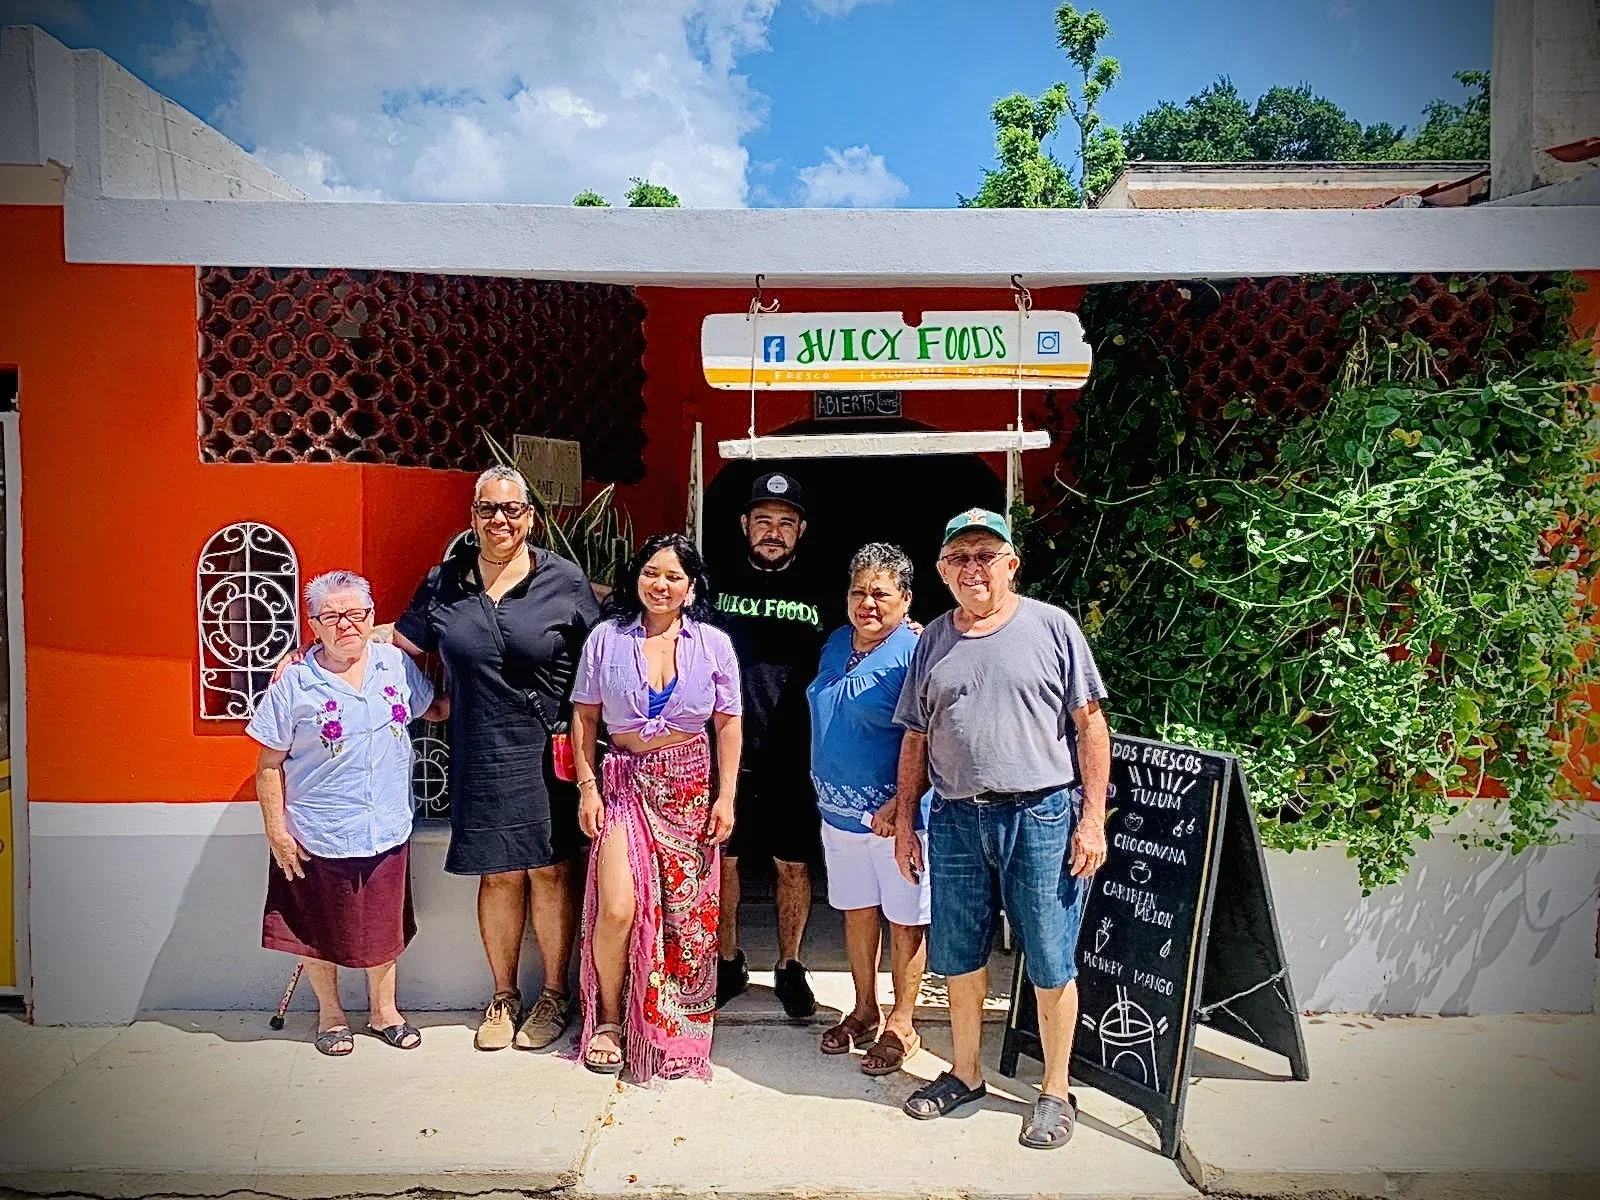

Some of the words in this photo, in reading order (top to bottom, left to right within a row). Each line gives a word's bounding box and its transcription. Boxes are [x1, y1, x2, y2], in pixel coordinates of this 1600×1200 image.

[797, 328, 903, 363] JUICY
[916, 326, 1007, 360] FOODS
[774, 371, 830, 380] FRESCO
[818, 394, 875, 415] ABIERTO
[714, 592, 761, 616] JUICY
[763, 599, 819, 625] FOODS
[1112, 742, 1138, 762] DOS
[1142, 746, 1202, 775] FRESCOS
[1131, 788, 1182, 811] TULUM
[1134, 903, 1174, 929] MELON
[1083, 950, 1124, 977] MONKEY
[1133, 969, 1174, 996] MANGO
